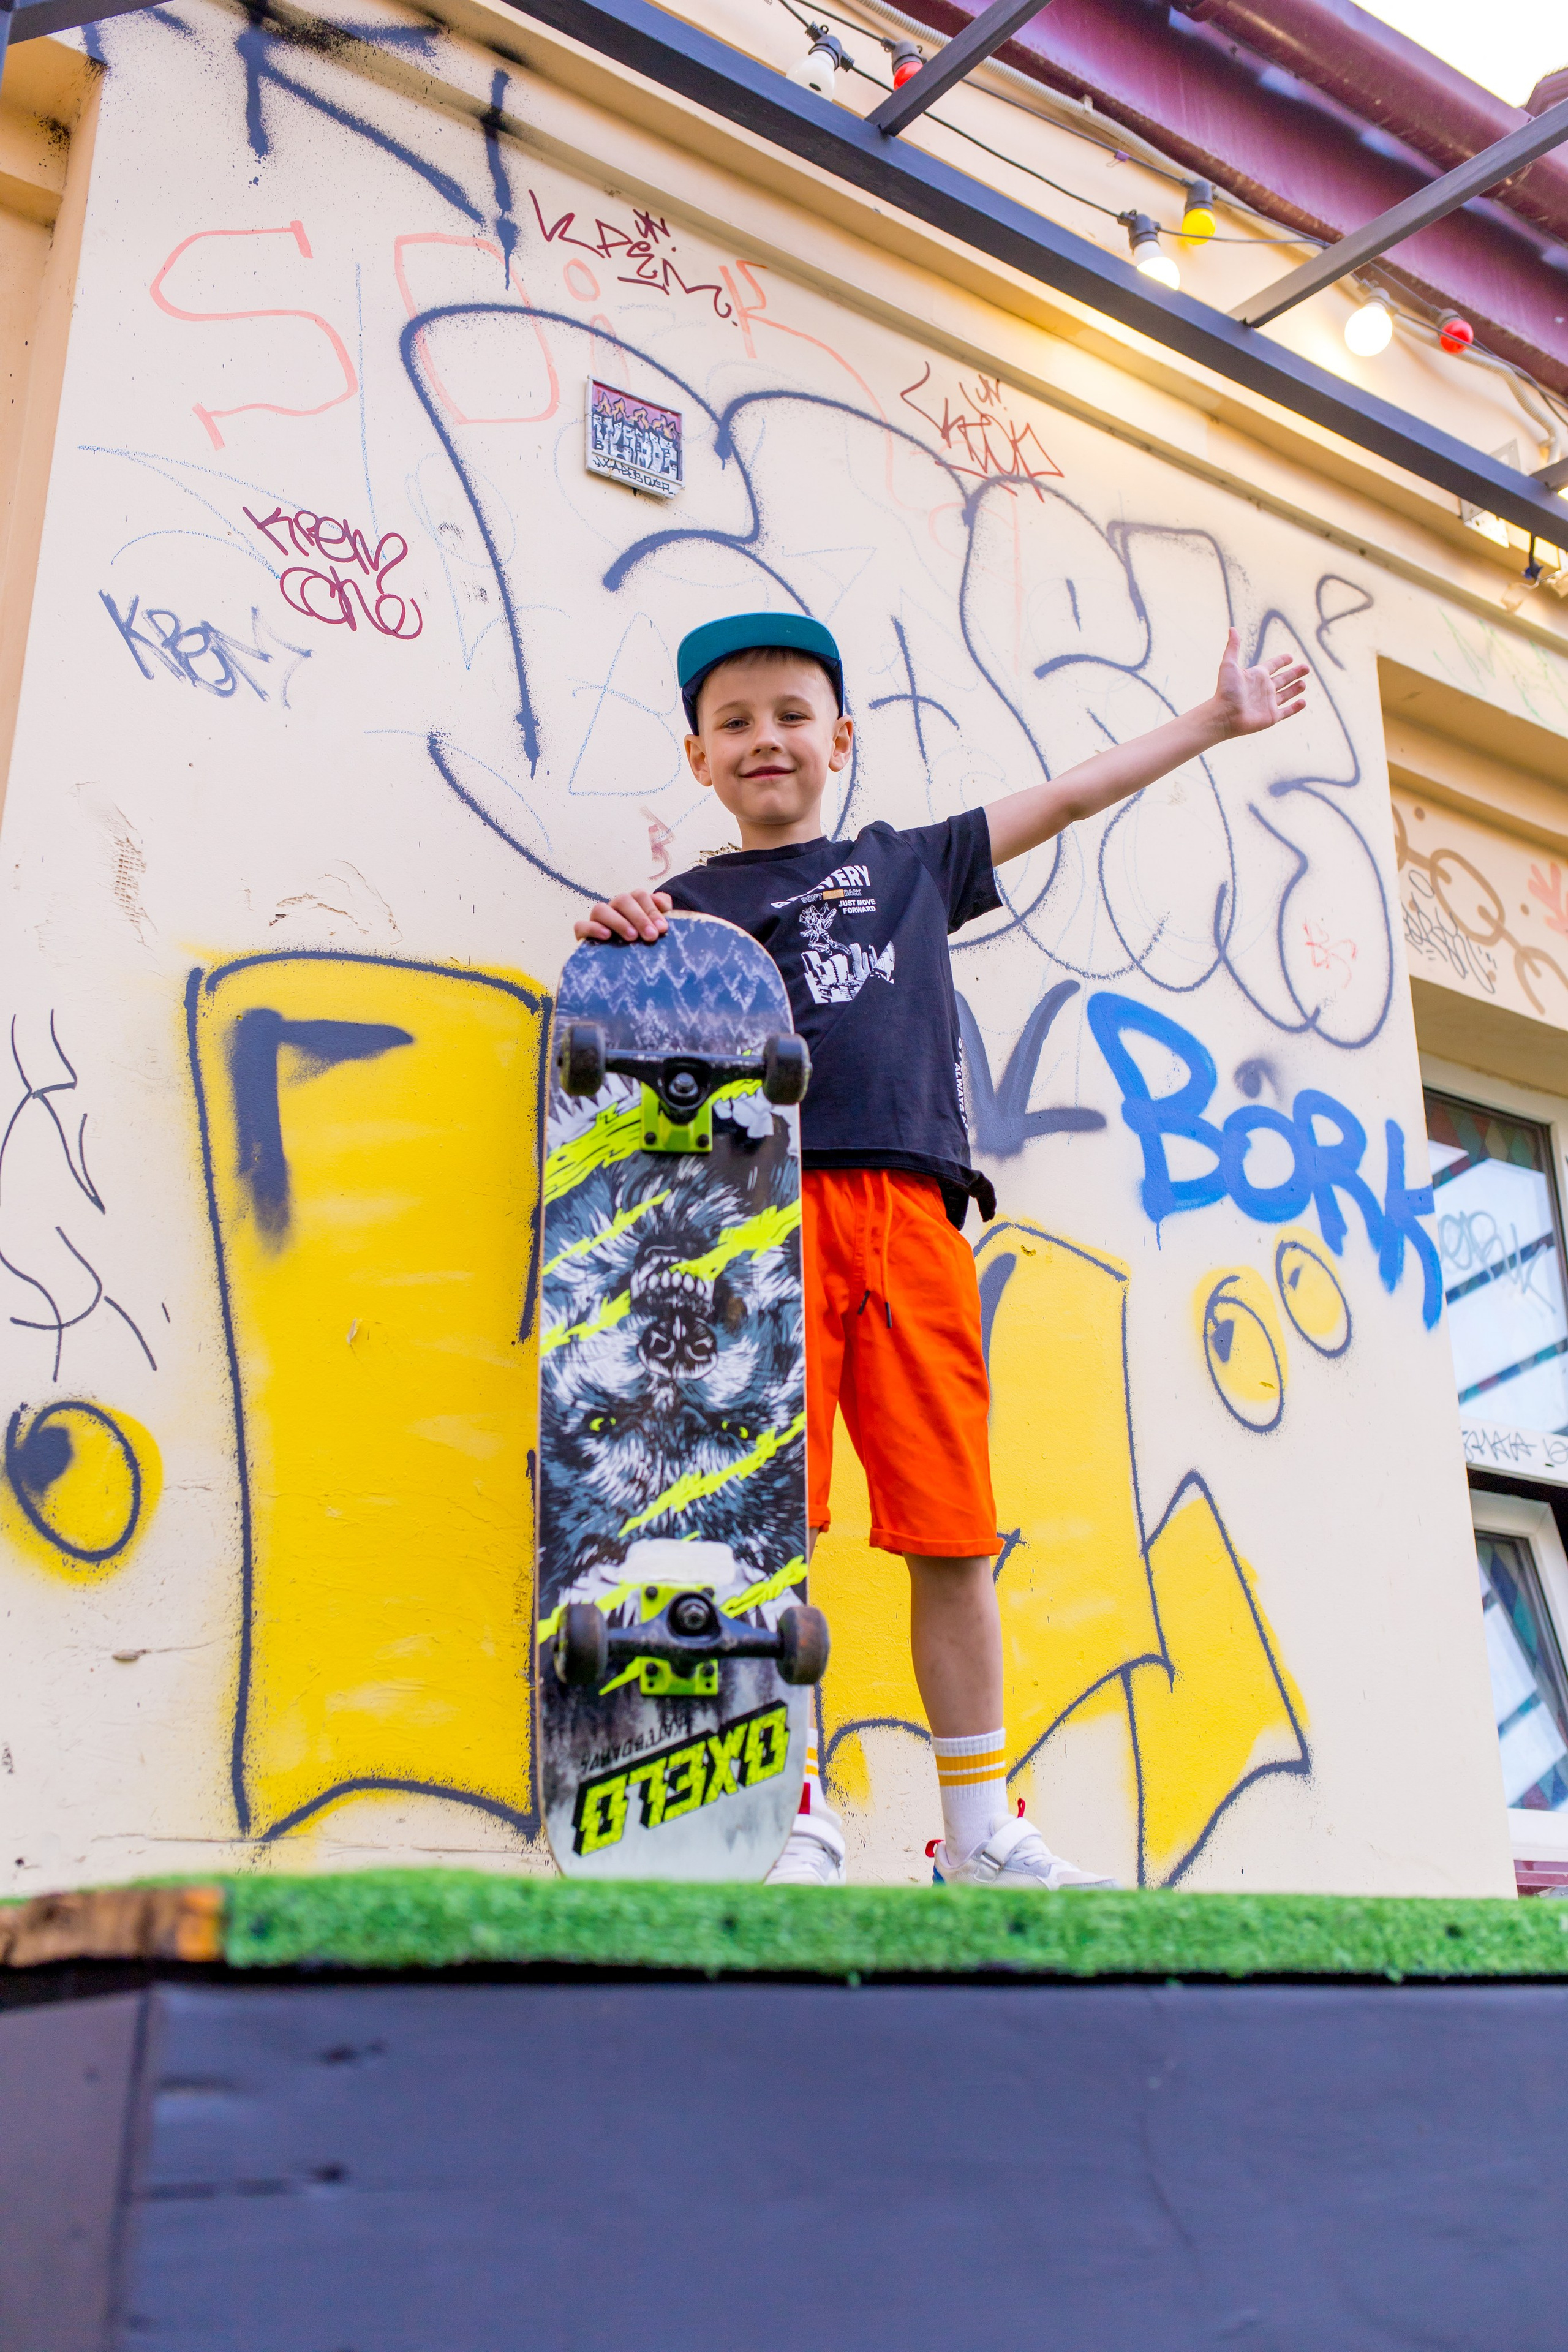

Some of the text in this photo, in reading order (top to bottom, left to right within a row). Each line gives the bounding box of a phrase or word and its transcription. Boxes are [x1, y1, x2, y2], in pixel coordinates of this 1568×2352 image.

[801, 892, 823, 903] DON'T
[954, 1062, 965, 1112] ALWAYS
[572, 1700, 790, 1858] OXELO
